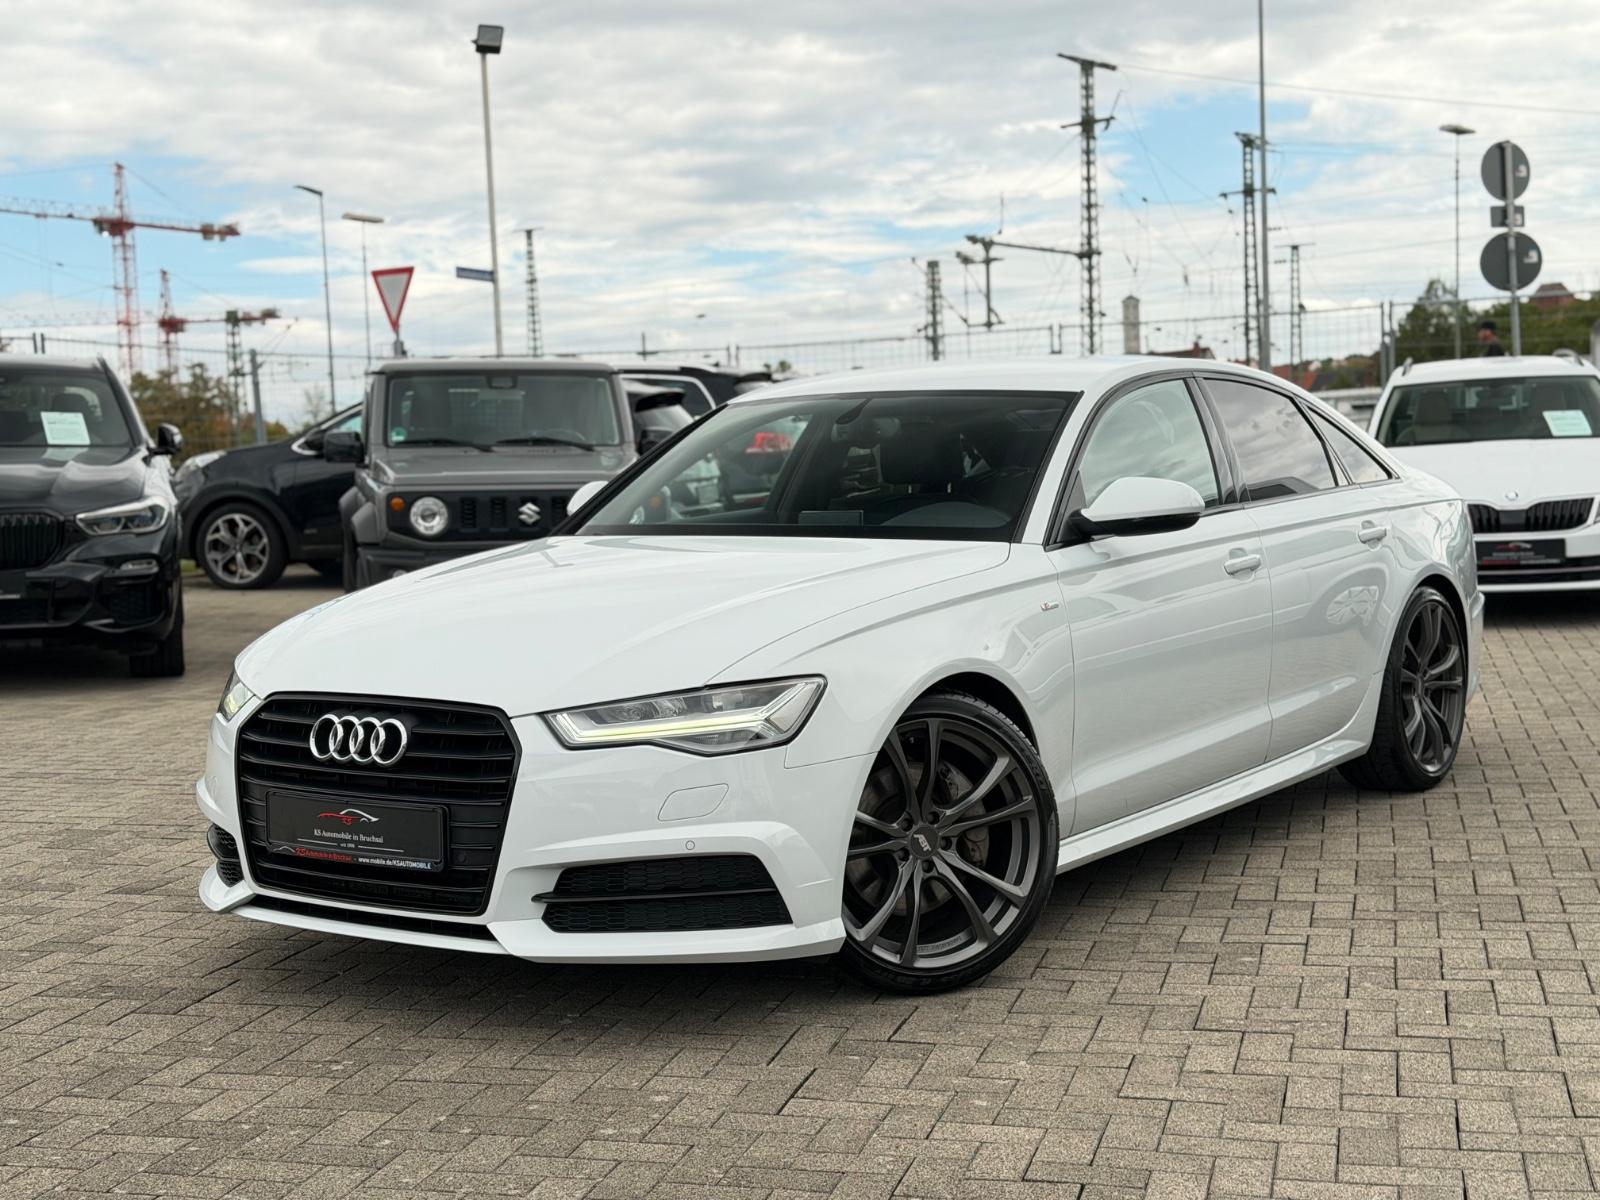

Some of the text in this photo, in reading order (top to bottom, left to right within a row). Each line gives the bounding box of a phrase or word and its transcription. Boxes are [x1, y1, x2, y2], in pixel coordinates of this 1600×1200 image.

[322, 830, 352, 840] Automobile
[353, 833, 359, 841] in
[359, 834, 384, 843] Bruchsal
[913, 834, 932, 851] ABT
